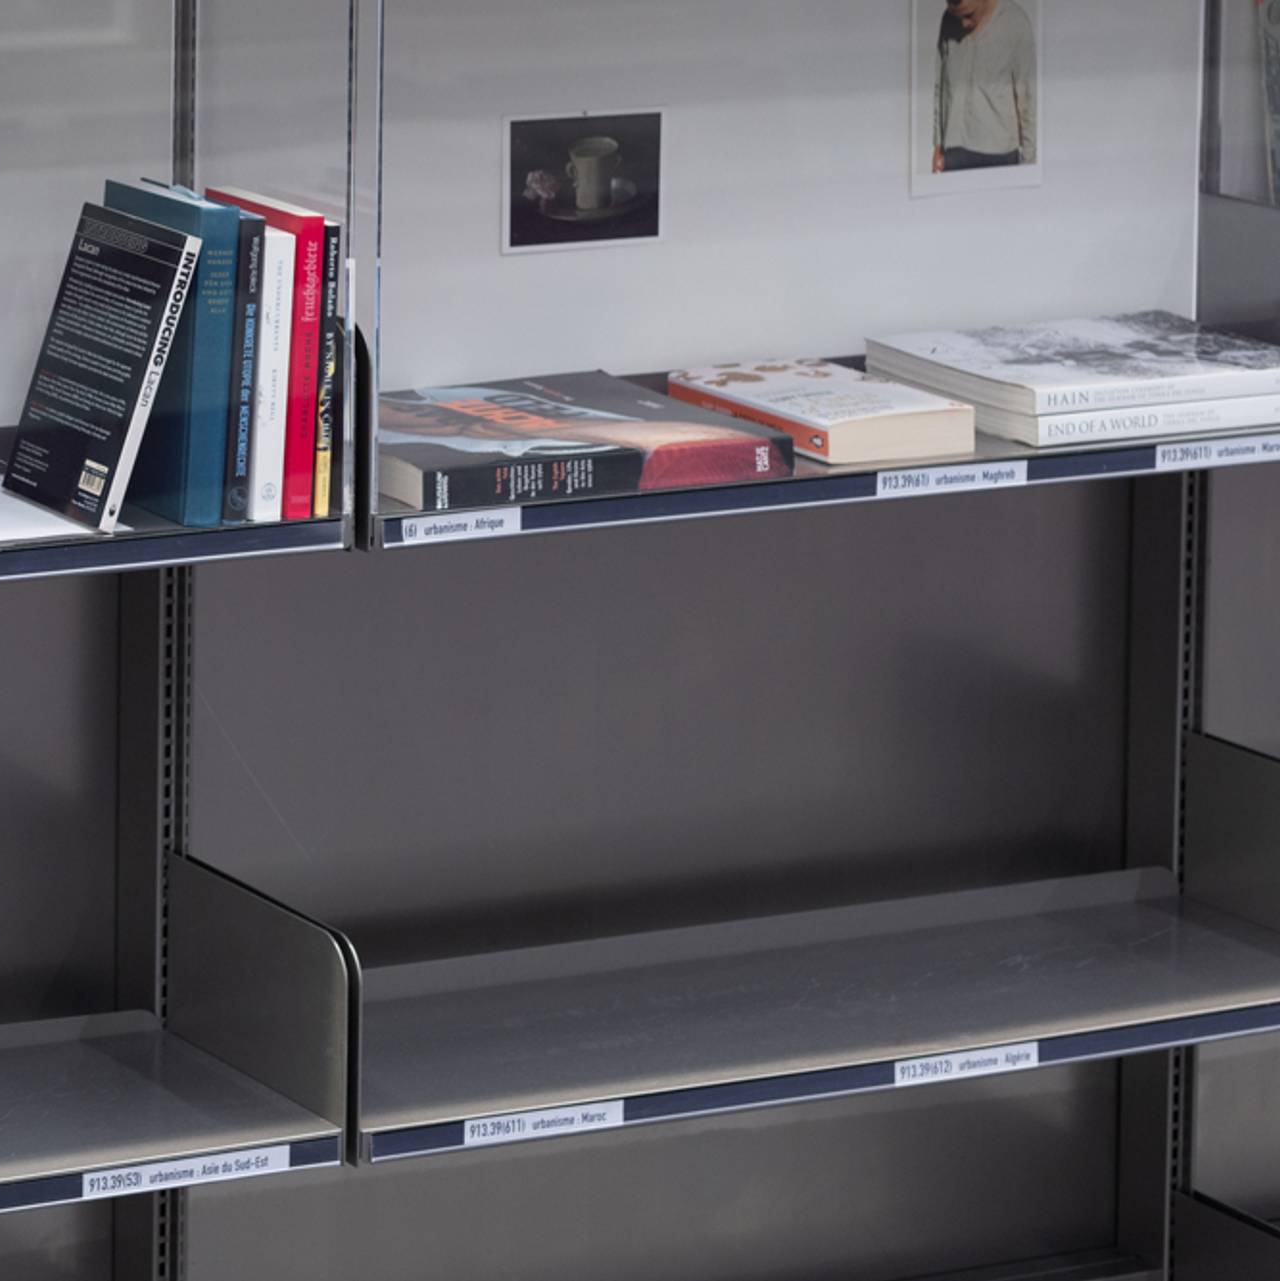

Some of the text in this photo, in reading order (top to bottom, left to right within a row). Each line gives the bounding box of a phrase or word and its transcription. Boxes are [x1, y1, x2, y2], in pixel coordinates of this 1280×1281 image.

[328, 237, 338, 278] Roberto
[140, 251, 196, 408] INTRODUCING Lacan
[326, 332, 334, 344] BY
[1048, 391, 1089, 407] HAIN
[1048, 424, 1076, 438] END
[1078, 422, 1094, 434] OF
[1099, 420, 1108, 432] A
[1110, 414, 1158, 432] WORLD
[1217, 443, 1256, 458] urbanisme
[936, 473, 976, 486] urbanisme
[983, 468, 1015, 484] Maghreb
[424, 522, 468, 536] urbanisme
[474, 518, 504, 531] Afrique
[959, 1056, 998, 1072] urbanisme
[470, 1112, 607, 1138] 913.39(611) urbanisme Maroc
[90, 1156, 268, 1192] 913.39(53) urbanisme Asie du Sud-Est
